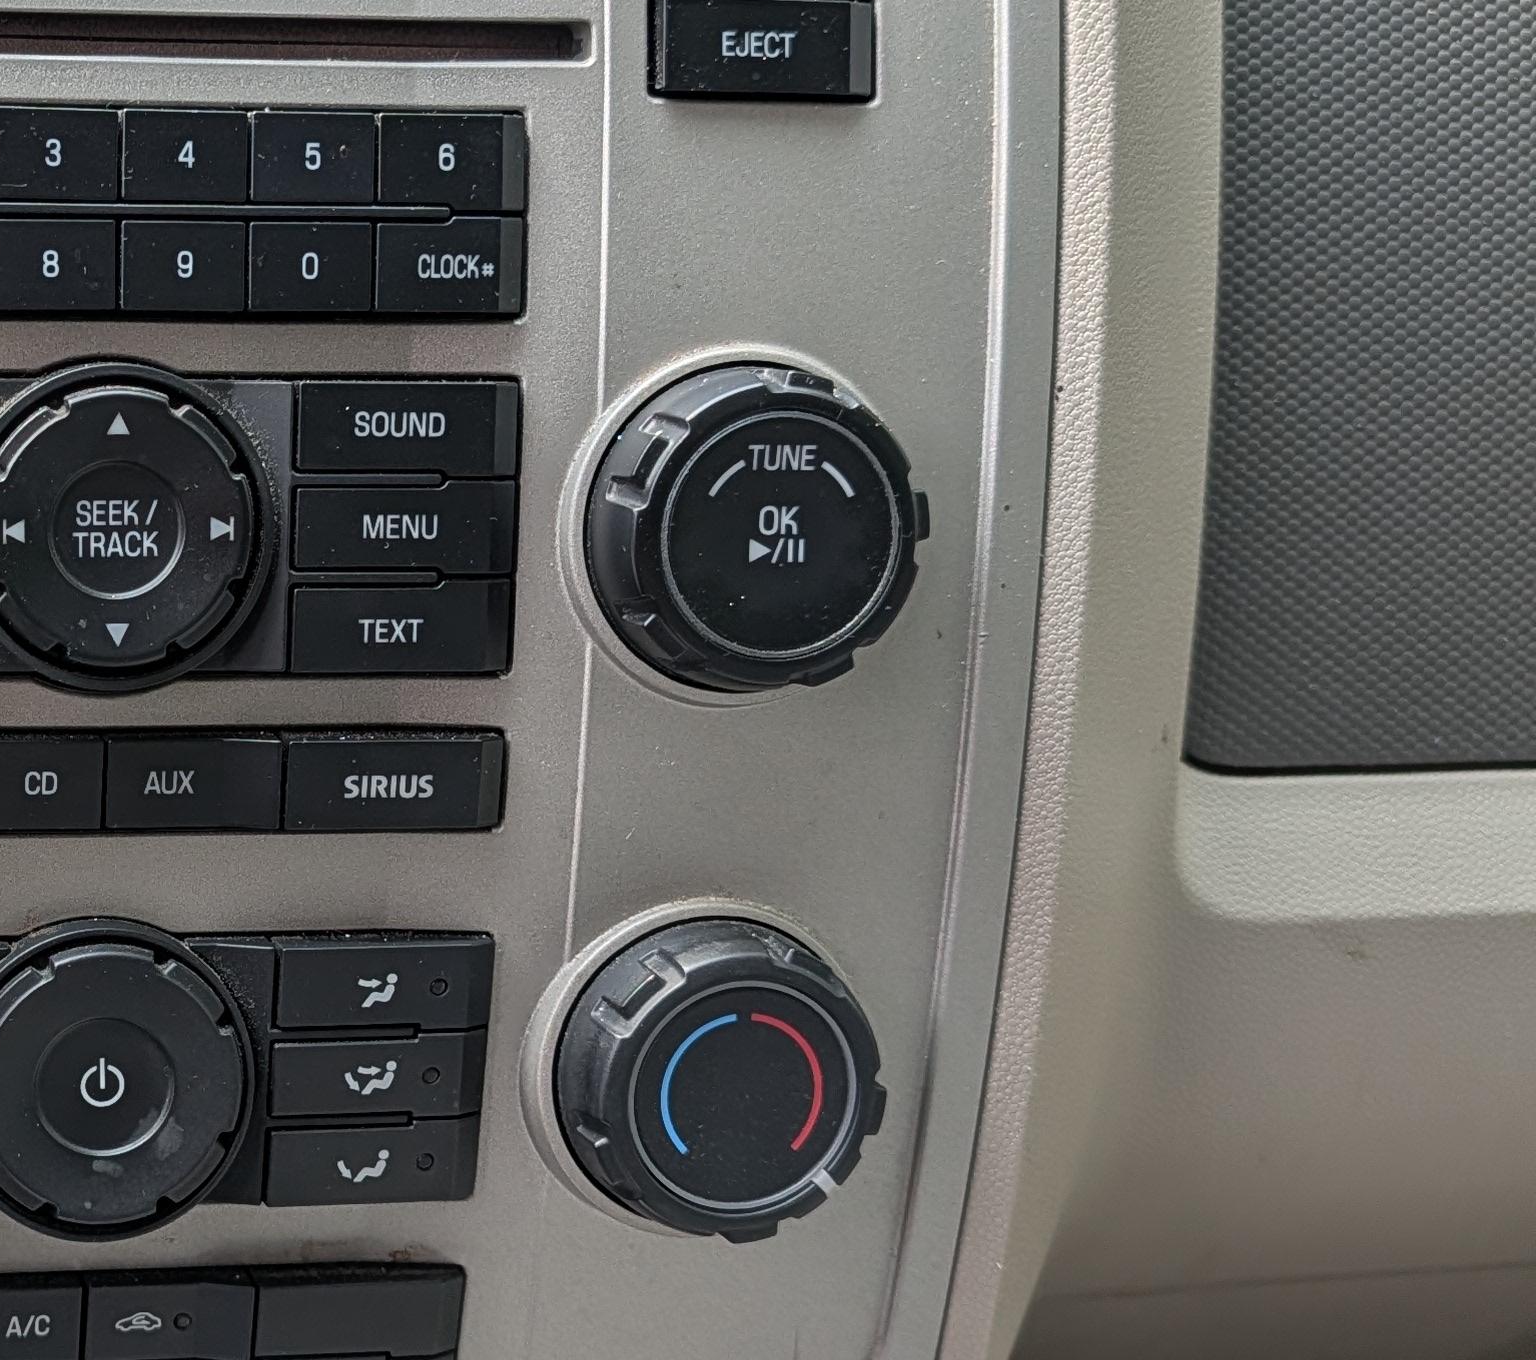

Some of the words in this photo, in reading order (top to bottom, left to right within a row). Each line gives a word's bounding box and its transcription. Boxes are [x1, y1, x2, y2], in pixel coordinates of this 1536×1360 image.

[721, 30, 796, 59] EJECT
[44, 138, 62, 167] 3
[177, 140, 196, 169] 4
[305, 142, 321, 171] 5
[438, 143, 455, 172] 6
[42, 249, 60, 278] 8
[176, 250, 194, 279] 9
[301, 251, 319, 280] 0
[417, 253, 495, 280] CLOCK#
[354, 410, 446, 438] SOUND
[748, 444, 817, 471] TUNE
[362, 514, 438, 540] MENU
[758, 505, 800, 536] OK
[72, 530, 159, 558] TRACK
[358, 618, 424, 644] TEXT
[24, 771, 58, 796] CD
[143, 770, 195, 795] AUX
[344, 774, 434, 799] SIRIUS
[5, 1314, 51, 1338] A/C
